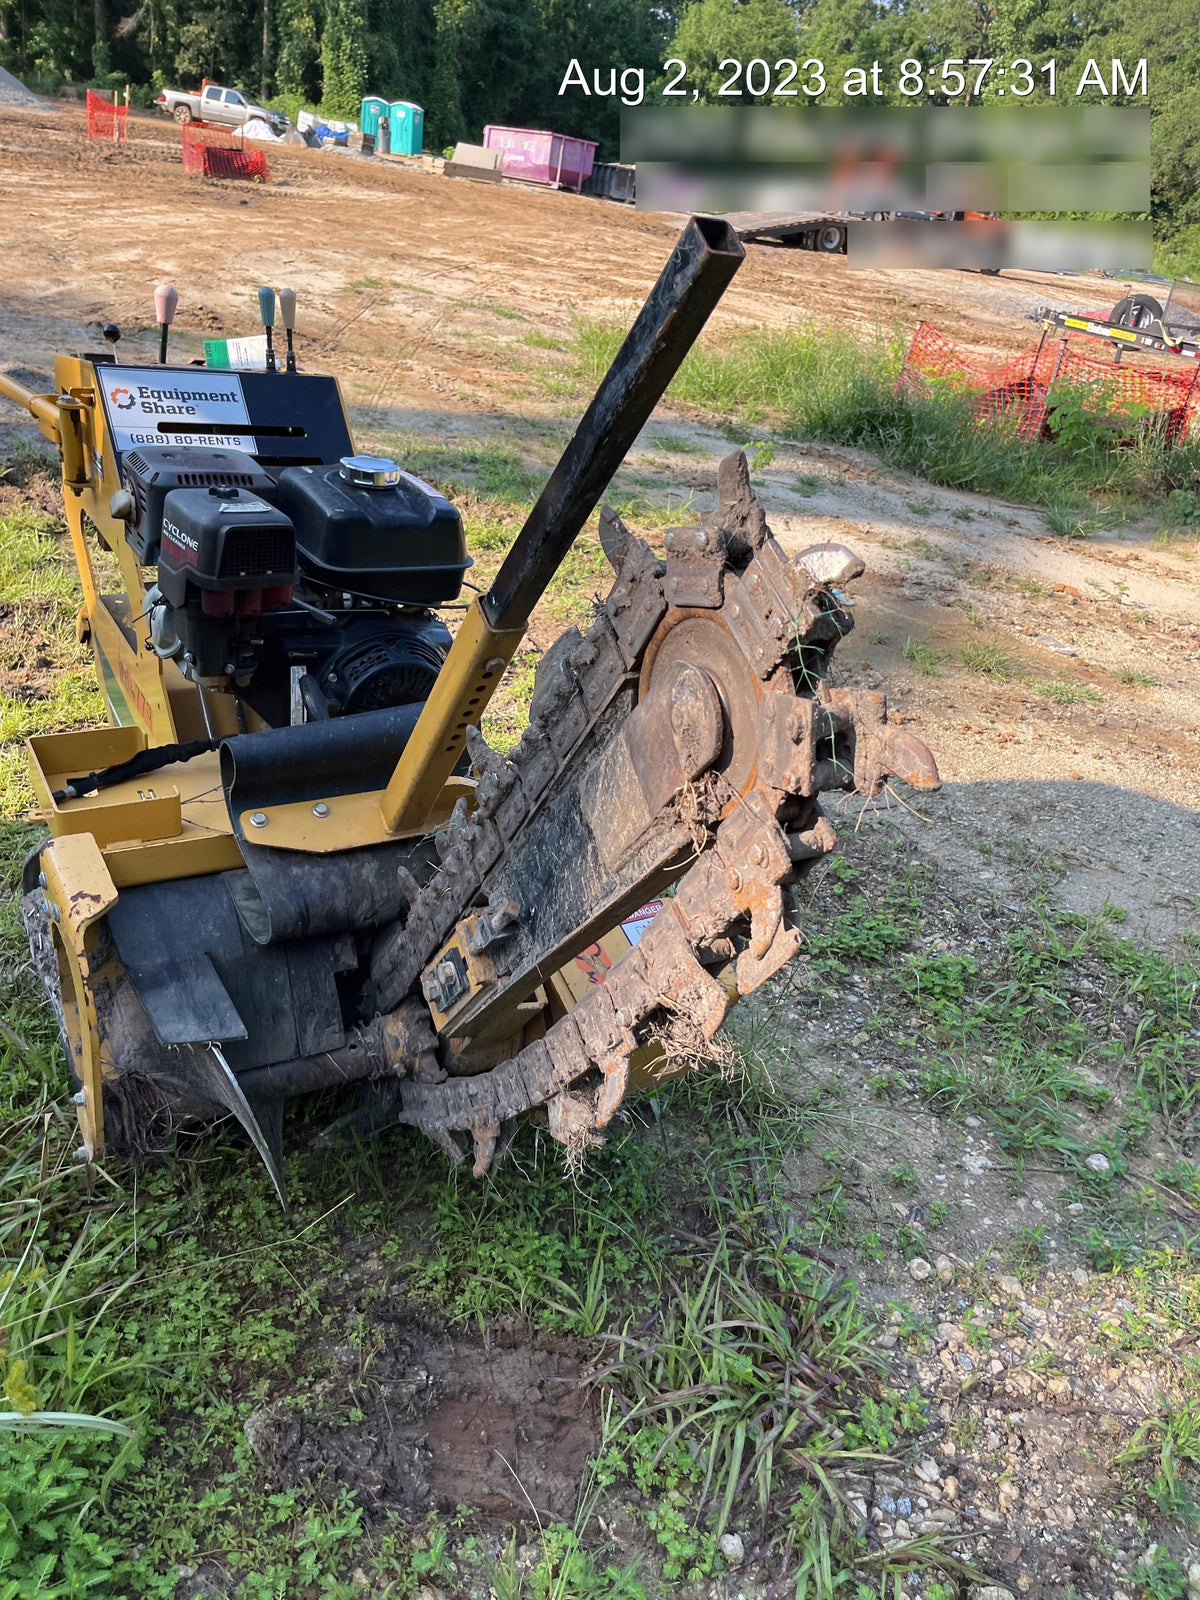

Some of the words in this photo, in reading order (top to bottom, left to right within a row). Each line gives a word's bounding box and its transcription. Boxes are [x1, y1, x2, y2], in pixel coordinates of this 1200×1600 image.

[137, 386, 239, 403] Equipment
[142, 401, 197, 415] Share
[130, 433, 170, 444] (888)
[175, 435, 242, 446] 80-RENTS
[163, 518, 199, 551] CYCLONE
